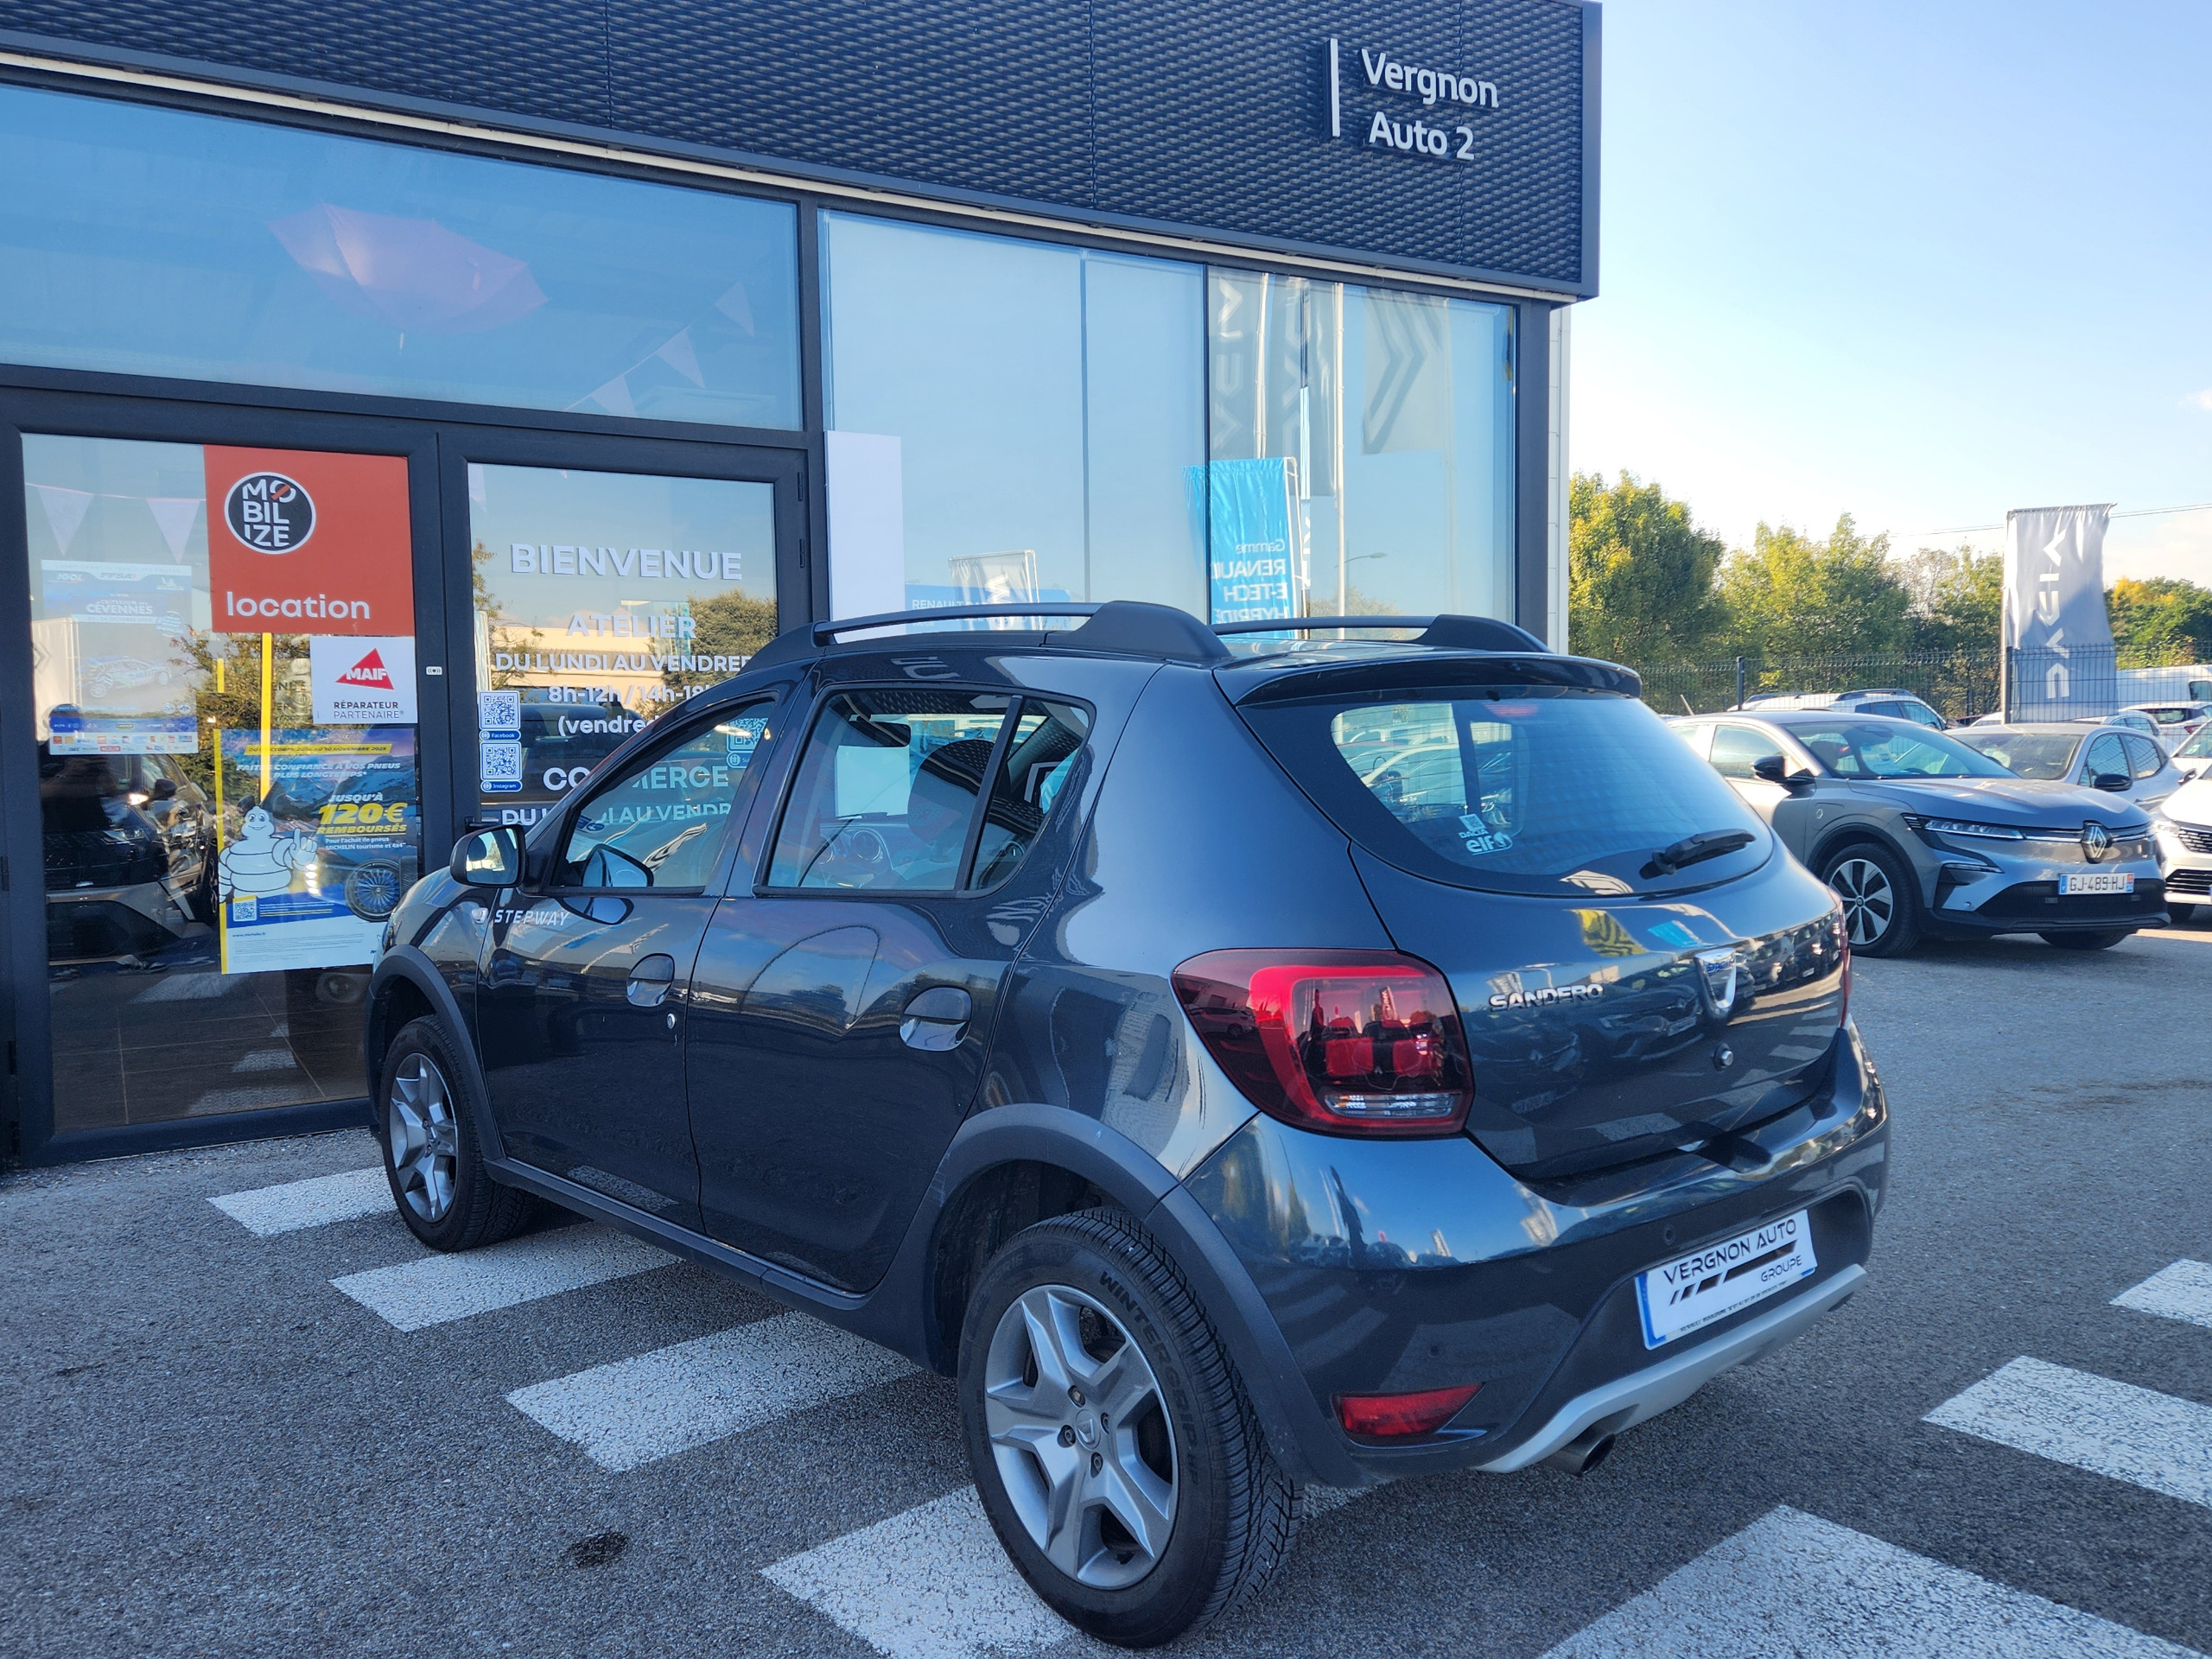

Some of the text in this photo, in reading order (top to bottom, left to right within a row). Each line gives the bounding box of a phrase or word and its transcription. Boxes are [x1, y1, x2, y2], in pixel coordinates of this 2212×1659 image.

[1360, 48, 1499, 108] Vergnon
[1369, 111, 1475, 161] Auto 2
[512, 543, 743, 581] BIENVENUE
[86, 601, 153, 615] CÉVENNES
[226, 591, 372, 620] location
[568, 614, 697, 639] ATELIER
[495, 652, 531, 671] DU
[536, 653, 611, 671] LUNDI
[613, 654, 648, 672] AU
[346, 668, 387, 682] MAIF
[334, 699, 398, 709] RÉPARATEUR
[548, 685, 622, 703] 8h-12h
[318, 802, 408, 825] 120€
[317, 824, 407, 835] REMBOURSÉS
[1465, 835, 1495, 853] elf
[2069, 876, 2126, 892] GJ-489-HJ
[494, 909, 571, 927] STEPWAY
[1489, 983, 1605, 1013] SANDERO
[1663, 1218, 1797, 1286] VERGNON AUTO
[1760, 1255, 1803, 1283] GROUPE
